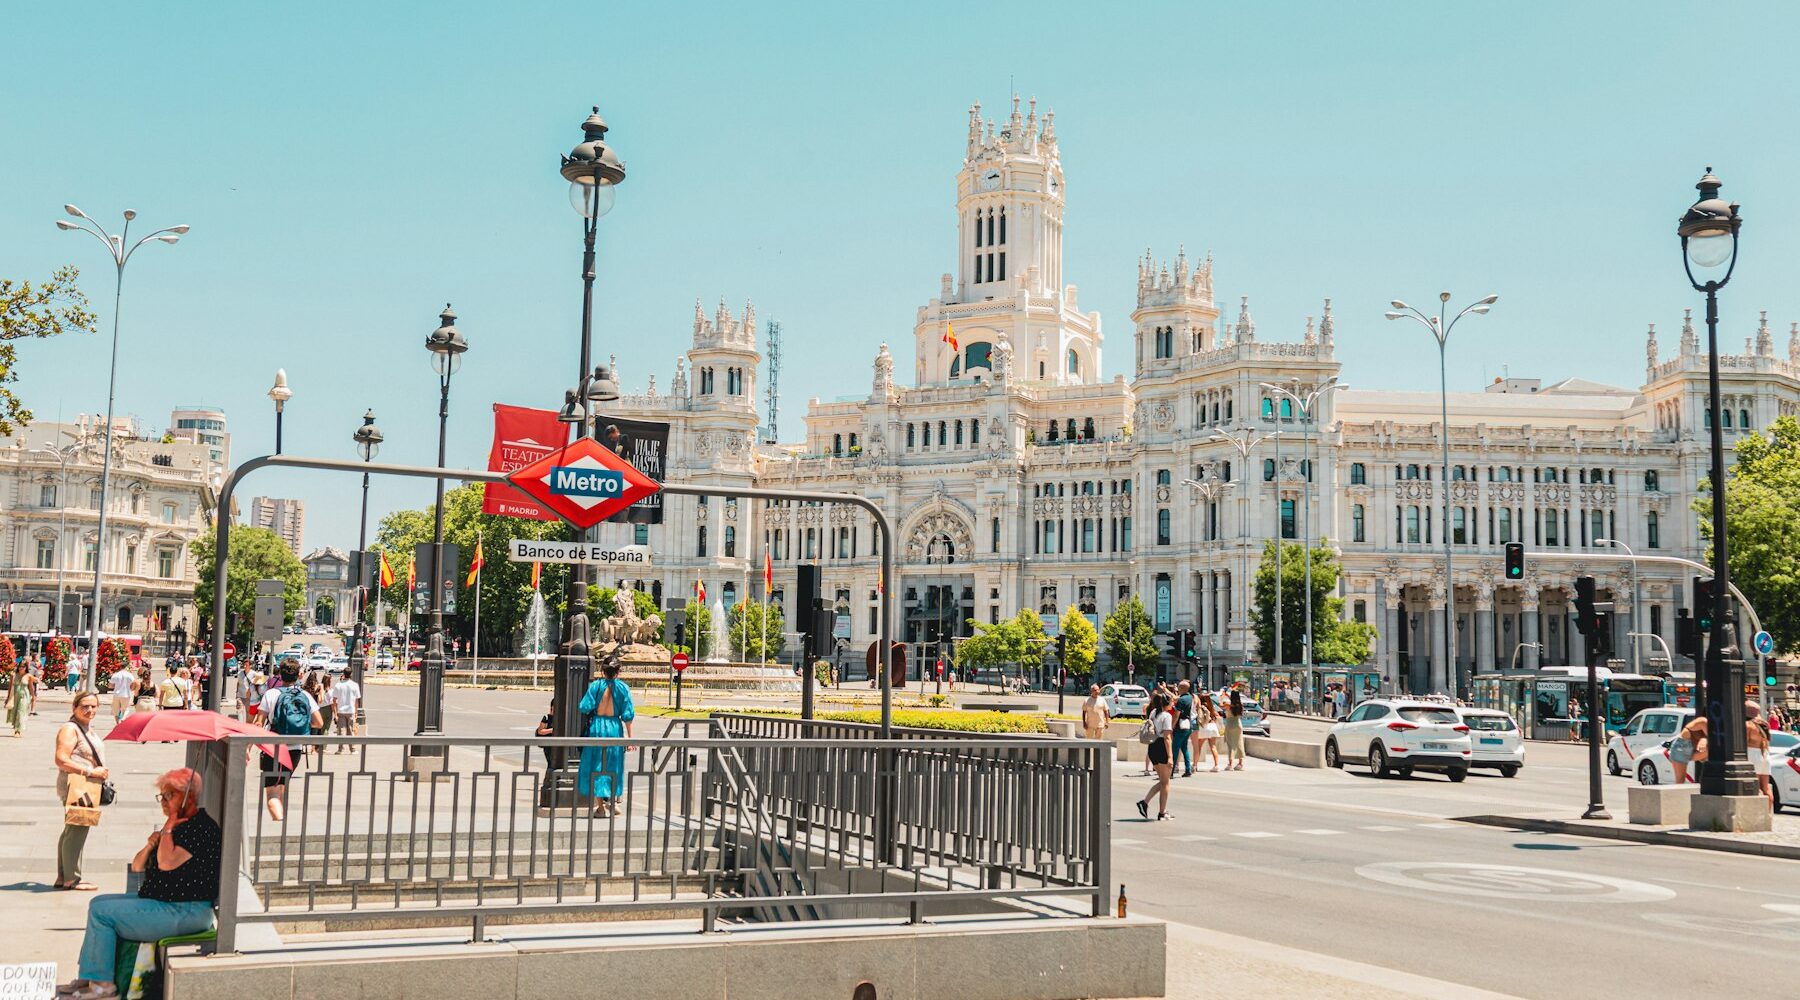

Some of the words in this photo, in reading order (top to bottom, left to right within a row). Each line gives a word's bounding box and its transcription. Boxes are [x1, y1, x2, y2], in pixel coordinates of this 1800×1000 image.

[502, 447, 548, 462] TEATR
[635, 438, 660, 457] VIAJE
[632, 454, 660, 473] HASTA
[557, 470, 618, 493] Metro
[508, 505, 539, 516] MADRID
[518, 543, 564, 559] Banco
[569, 546, 587, 560] de
[591, 547, 643, 564] España
